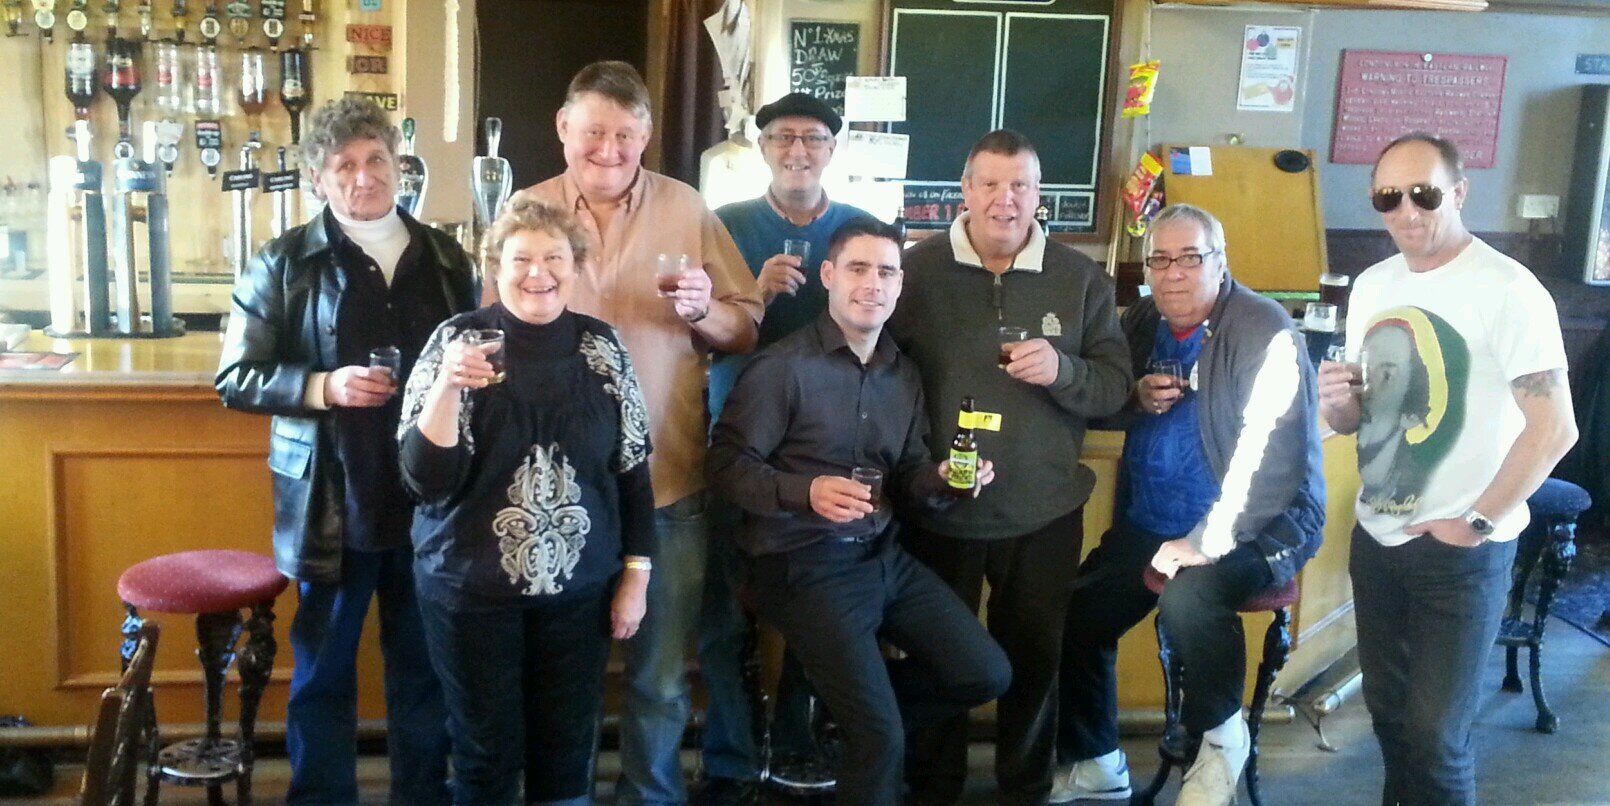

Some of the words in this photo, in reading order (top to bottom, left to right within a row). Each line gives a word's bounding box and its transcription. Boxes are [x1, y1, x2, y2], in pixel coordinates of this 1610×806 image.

[351, 28, 391, 41] NICE
[794, 47, 843, 64] DRAW
[1360, 72, 1401, 83] WARNING
